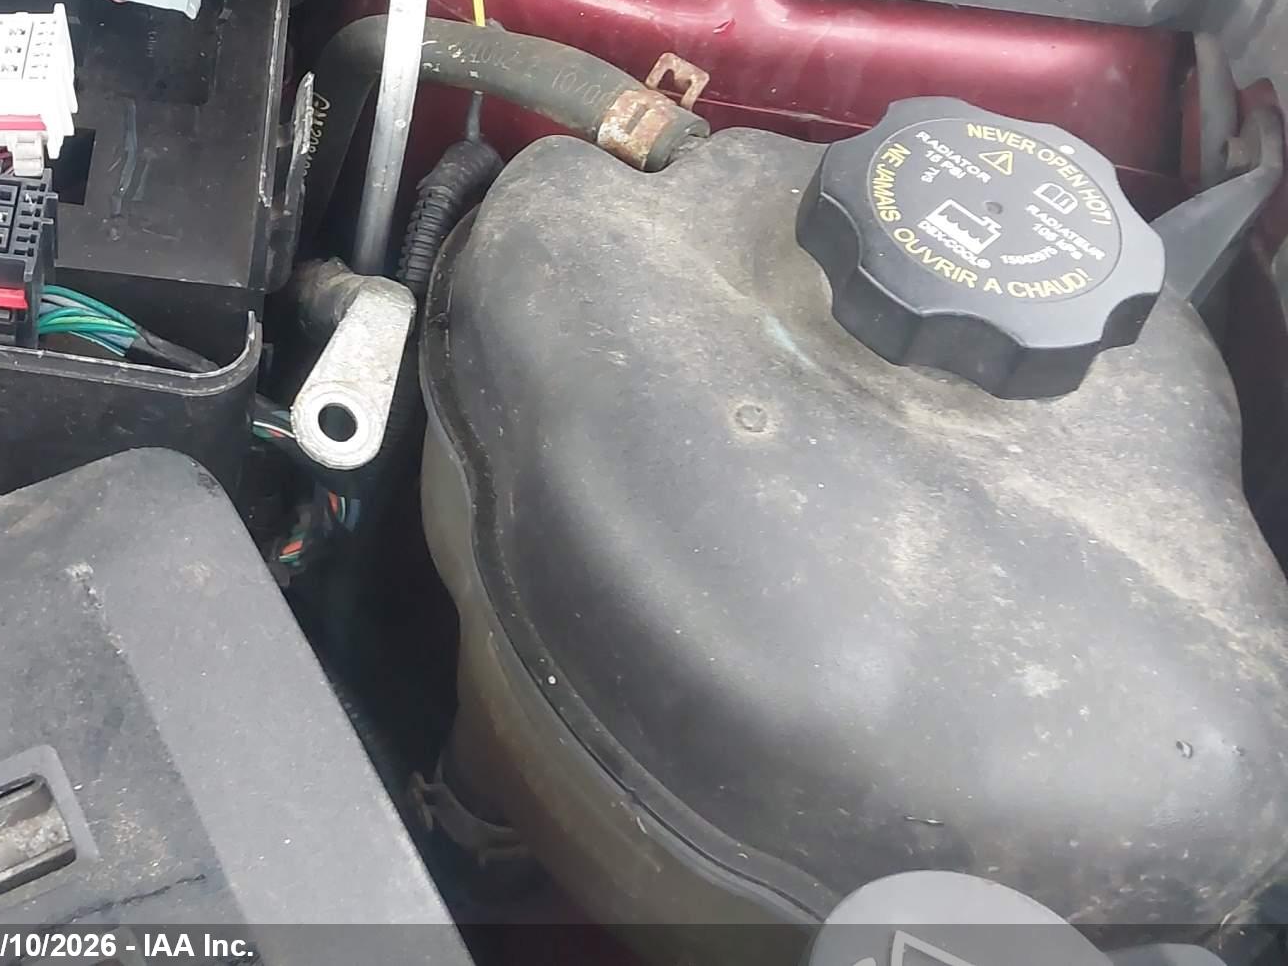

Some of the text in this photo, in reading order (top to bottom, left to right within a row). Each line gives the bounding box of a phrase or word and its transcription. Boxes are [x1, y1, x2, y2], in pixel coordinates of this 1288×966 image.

[882, 143, 912, 170] NE
[915, 130, 992, 184] RADIATOR
[940, 160, 968, 180] PSI
[967, 123, 1112, 227] NEVER OPEN HOT!
[872, 166, 902, 223] JAMAIS
[893, 227, 979, 288] OUVRIR
[1025, 204, 1106, 261] RADIATEUR
[983, 278, 1003, 295] A
[1007, 267, 1092, 299] CHAUD!
